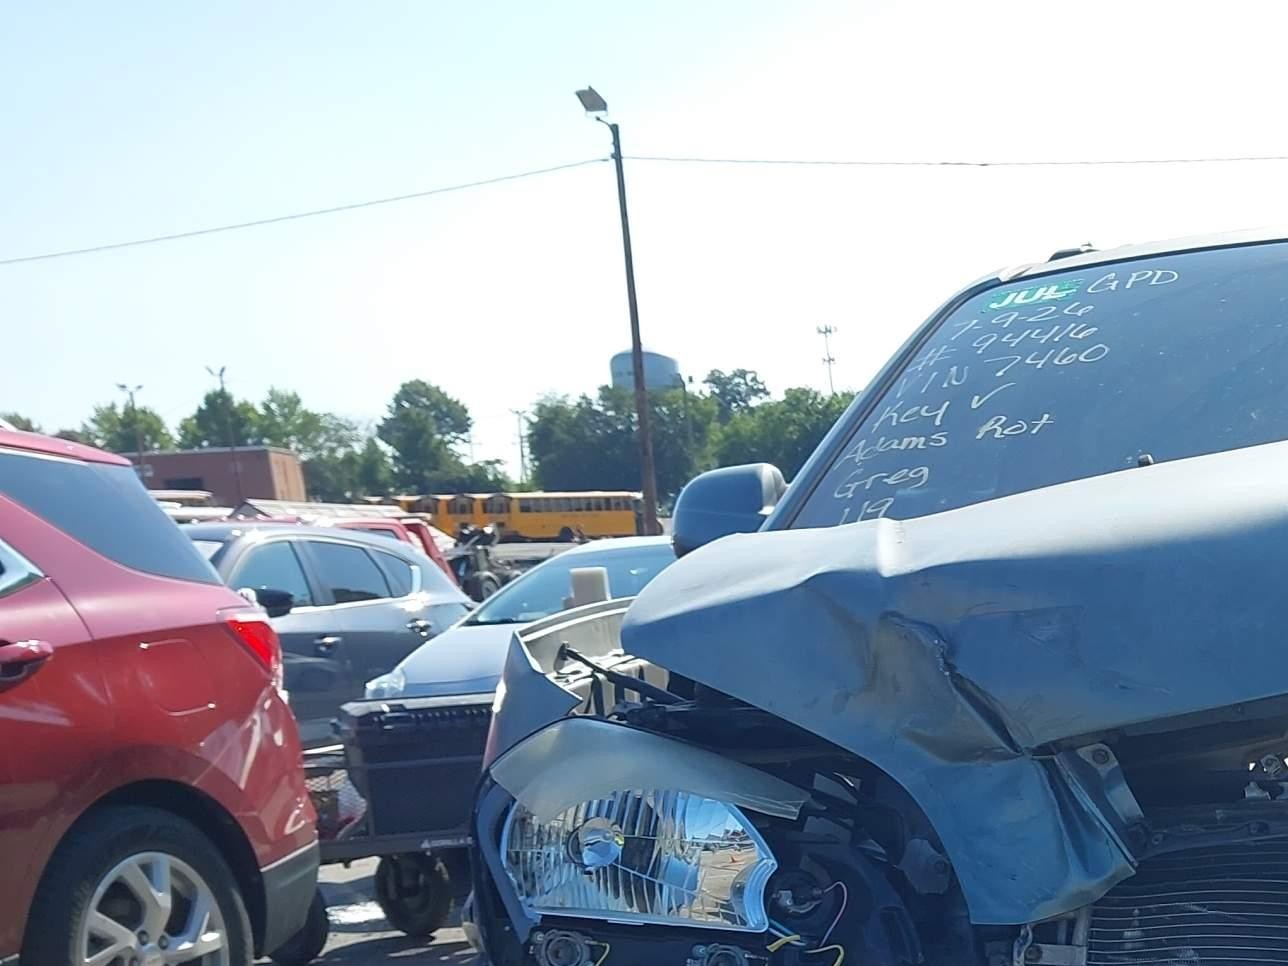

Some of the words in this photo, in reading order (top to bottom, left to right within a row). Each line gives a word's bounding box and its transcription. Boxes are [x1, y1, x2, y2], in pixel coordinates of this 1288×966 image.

[1086, 269, 1179, 294] GPD
[907, 345, 958, 372] #
[972, 323, 1099, 354] 94416
[983, 344, 1110, 377] 7460
[834, 466, 929, 499] Greg
